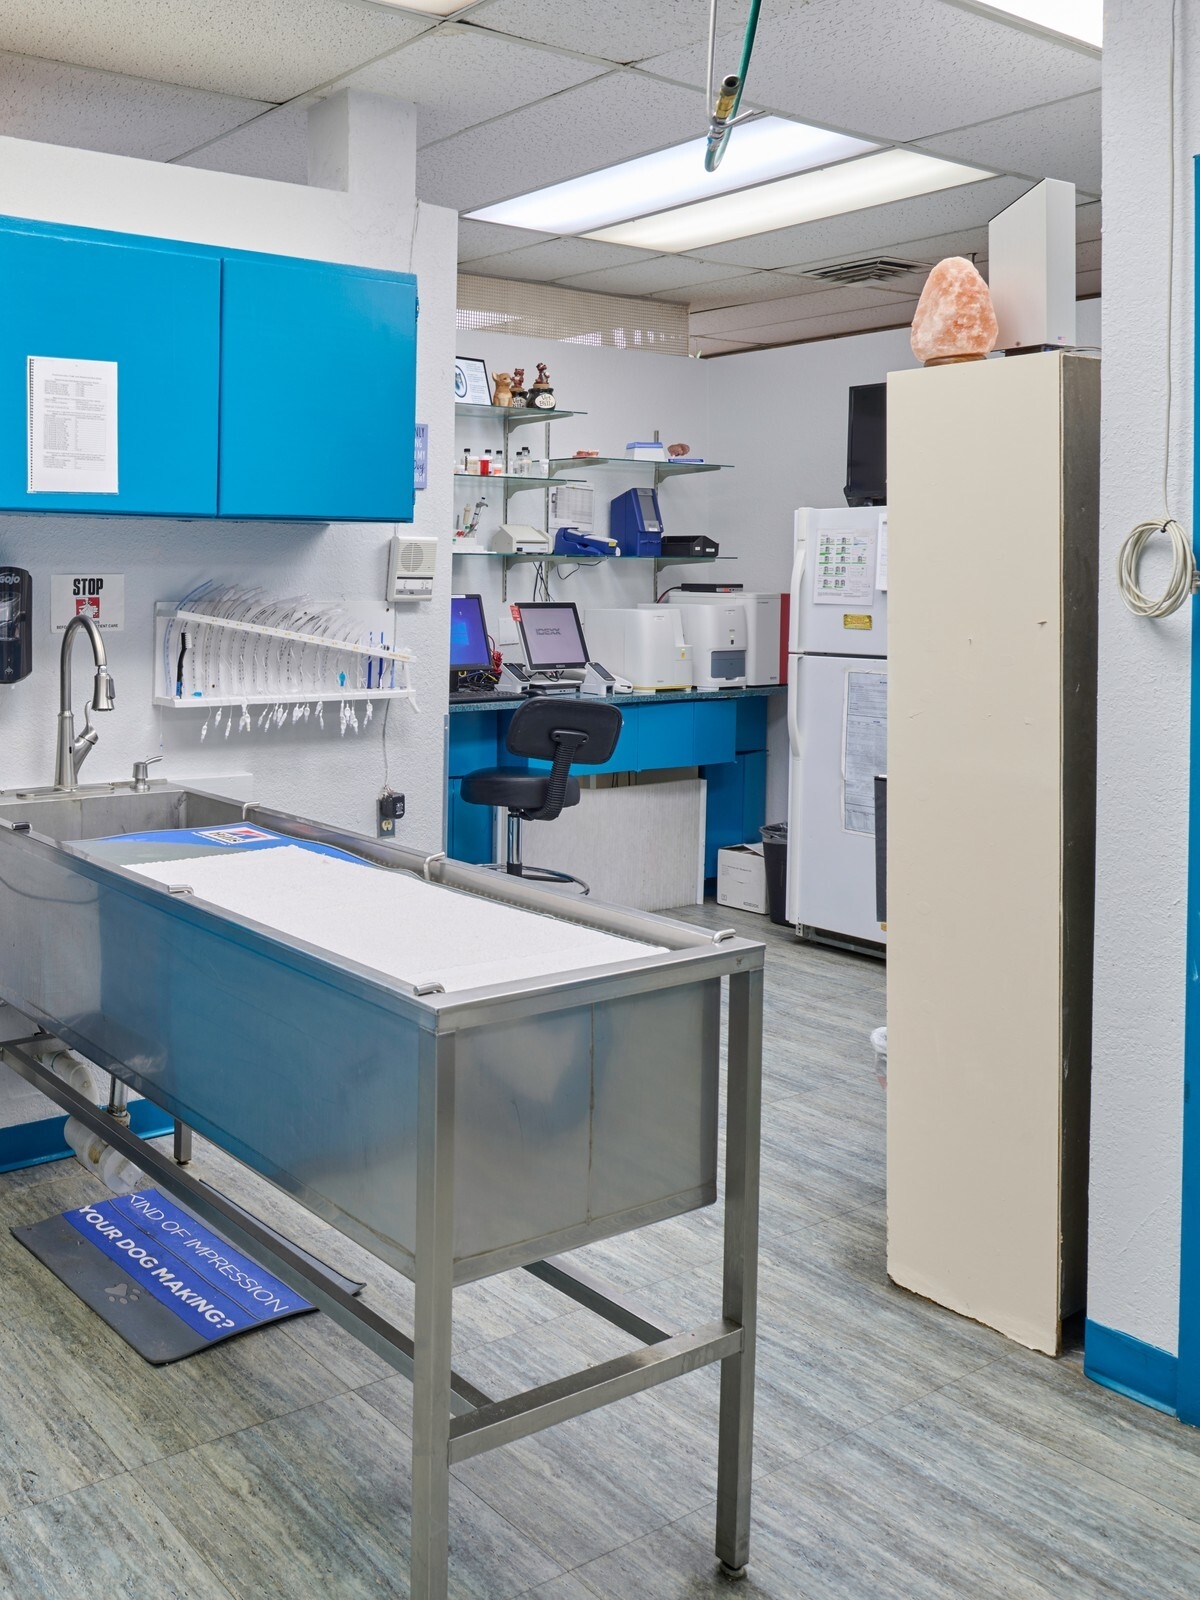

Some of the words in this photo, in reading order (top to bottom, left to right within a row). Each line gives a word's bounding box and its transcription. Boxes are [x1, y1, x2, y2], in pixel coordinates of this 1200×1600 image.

[72, 578, 104, 596] STOP
[79, 1205, 123, 1240] YOUR
[116, 1238, 159, 1269] DOG
[151, 1267, 235, 1329] MAKING?
[130, 1193, 165, 1221] KIND
[161, 1221, 191, 1238] OF
[183, 1238, 289, 1313] IMPRESSION
